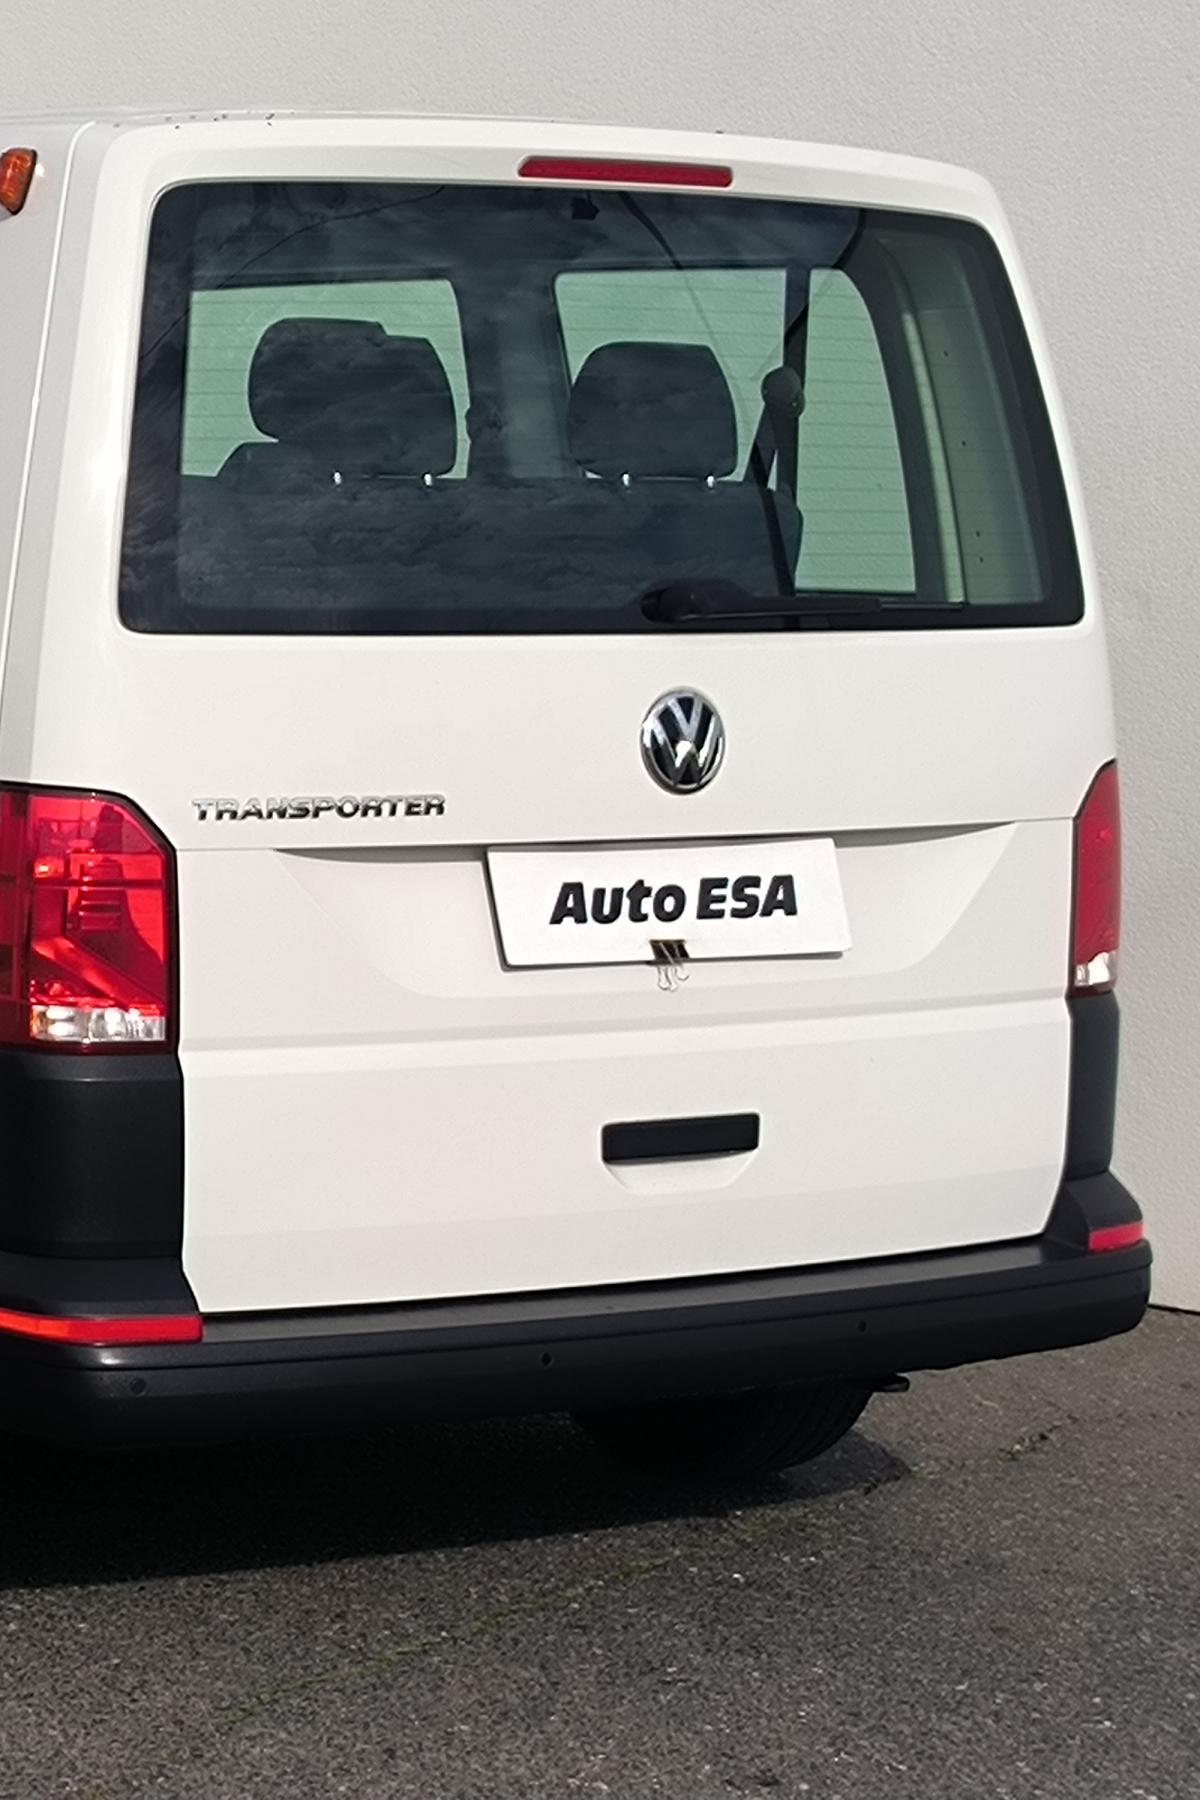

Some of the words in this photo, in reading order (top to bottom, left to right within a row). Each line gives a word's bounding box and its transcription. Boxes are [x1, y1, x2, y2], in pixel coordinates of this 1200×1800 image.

[193, 795, 446, 821] TRANSPORTER
[549, 878, 686, 925] Auto
[696, 874, 798, 920] ESA
